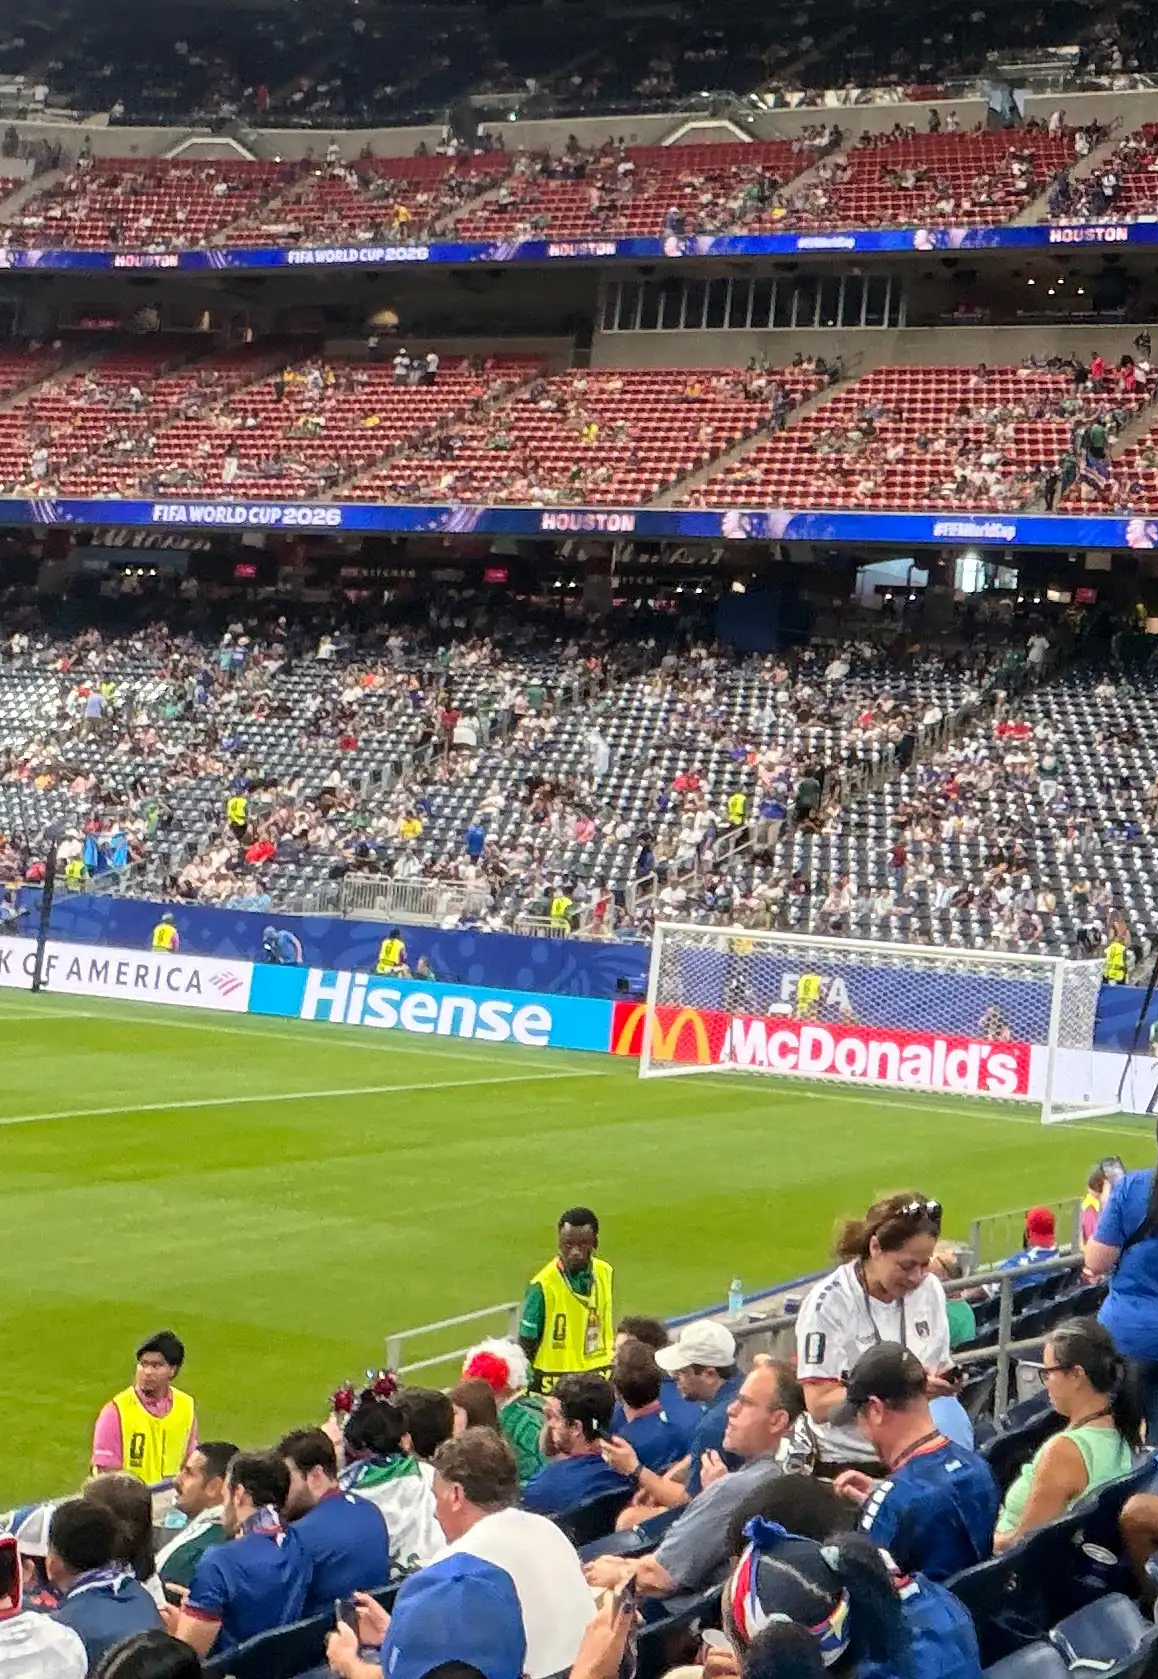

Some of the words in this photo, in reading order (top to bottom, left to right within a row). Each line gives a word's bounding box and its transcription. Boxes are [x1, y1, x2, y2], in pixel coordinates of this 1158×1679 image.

[1049, 226, 1128, 243] HOUSTON
[288, 249, 314, 264] FIFA
[315, 248, 358, 262] WORLD
[359, 247, 384, 262] CUP
[153, 504, 188, 522] FIFA
[189, 505, 247, 524] WORLD
[248, 507, 282, 525] CUP
[282, 508, 341, 526] 2026
[542, 513, 635, 531] HOUSTON
[65, 956, 202, 995] AMERICA
[300, 968, 552, 1046] Hisense
[719, 1017, 1019, 1096] McDonald's
